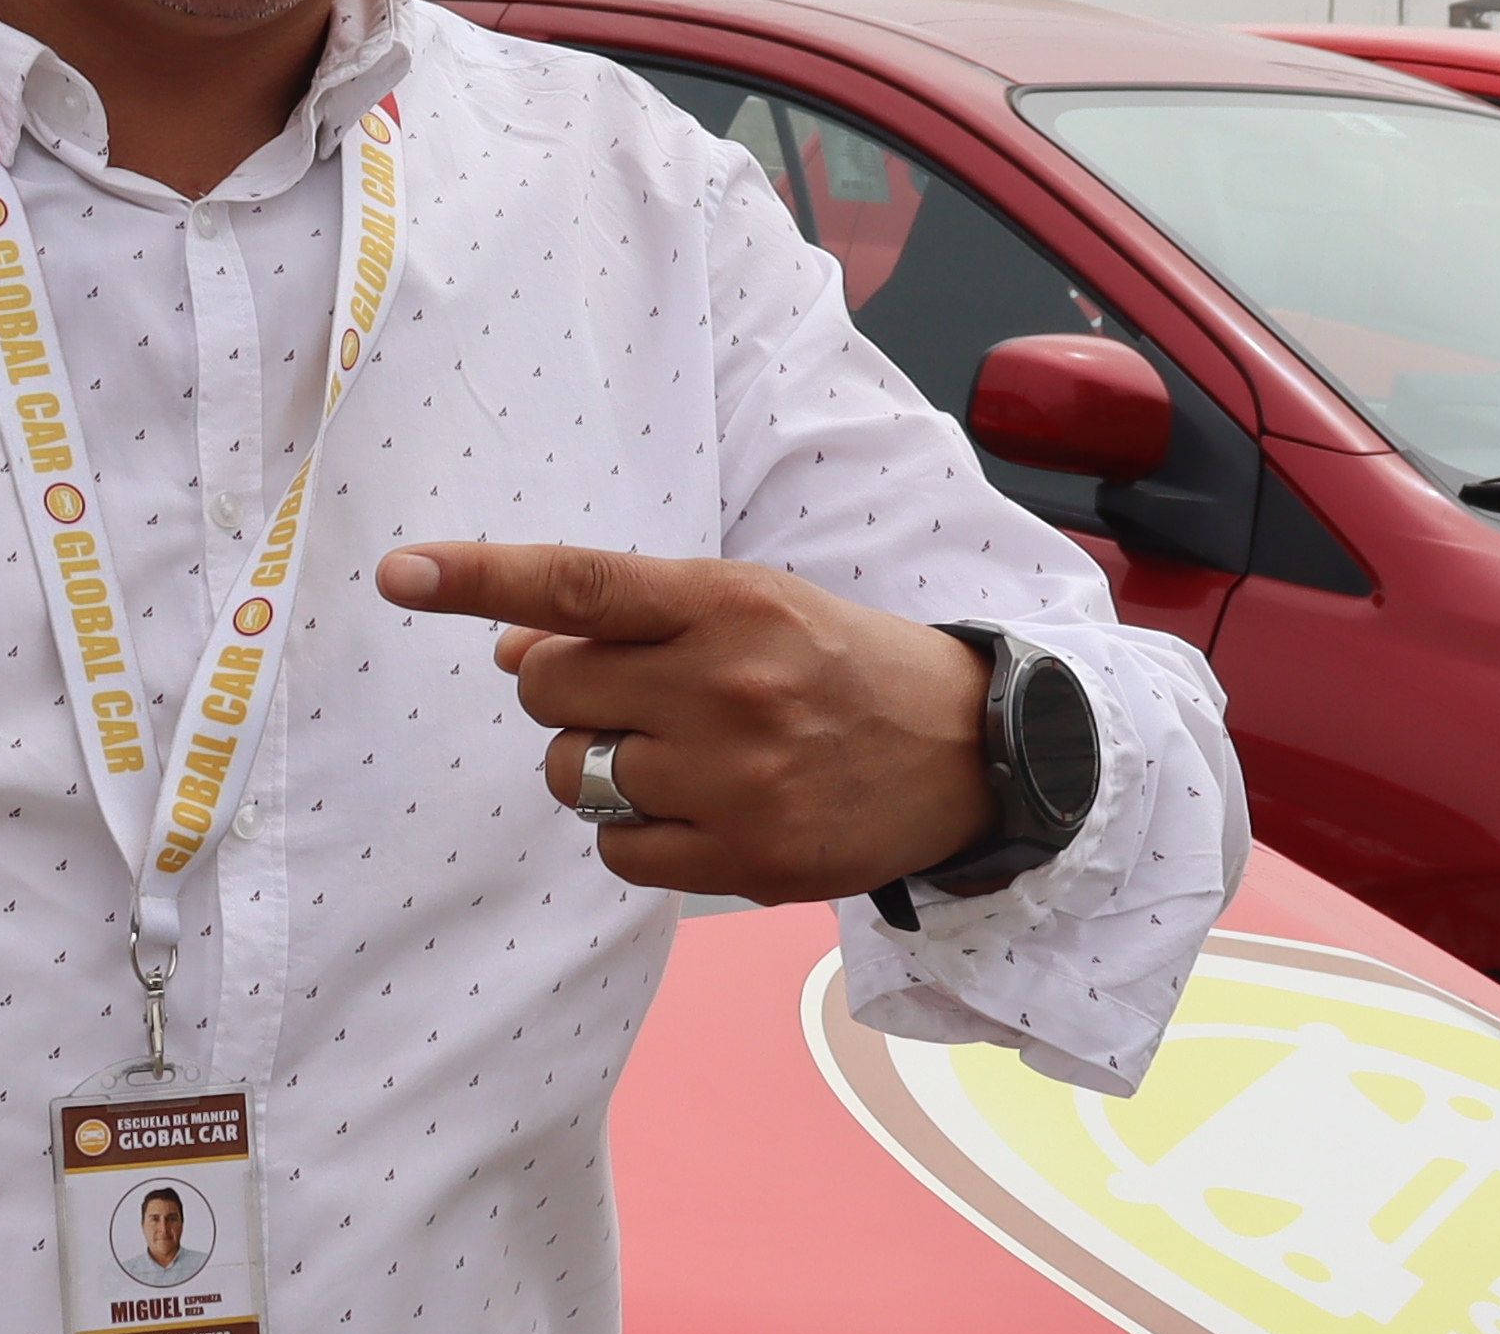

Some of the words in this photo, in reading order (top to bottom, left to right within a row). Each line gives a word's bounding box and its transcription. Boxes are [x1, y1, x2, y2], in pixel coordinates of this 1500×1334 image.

[361, 142, 396, 209] CAR
[350, 205, 396, 334] GLOBAL
[15, 391, 73, 475] CAR
[250, 449, 316, 588] GLOBA
[53, 530, 127, 683] GLOBAL
[91, 689, 145, 774] CAR
[155, 732, 239, 874] GLOBAL
[201, 645, 265, 726] CAR
[117, 1114, 171, 1130] ESCUELA
[173, 1113, 189, 1125] DE
[190, 1109, 240, 1124] MANEJO
[118, 1128, 195, 1150] GLOBAL
[198, 1124, 238, 1143] CAR
[111, 1297, 183, 1324] MIGUEL
